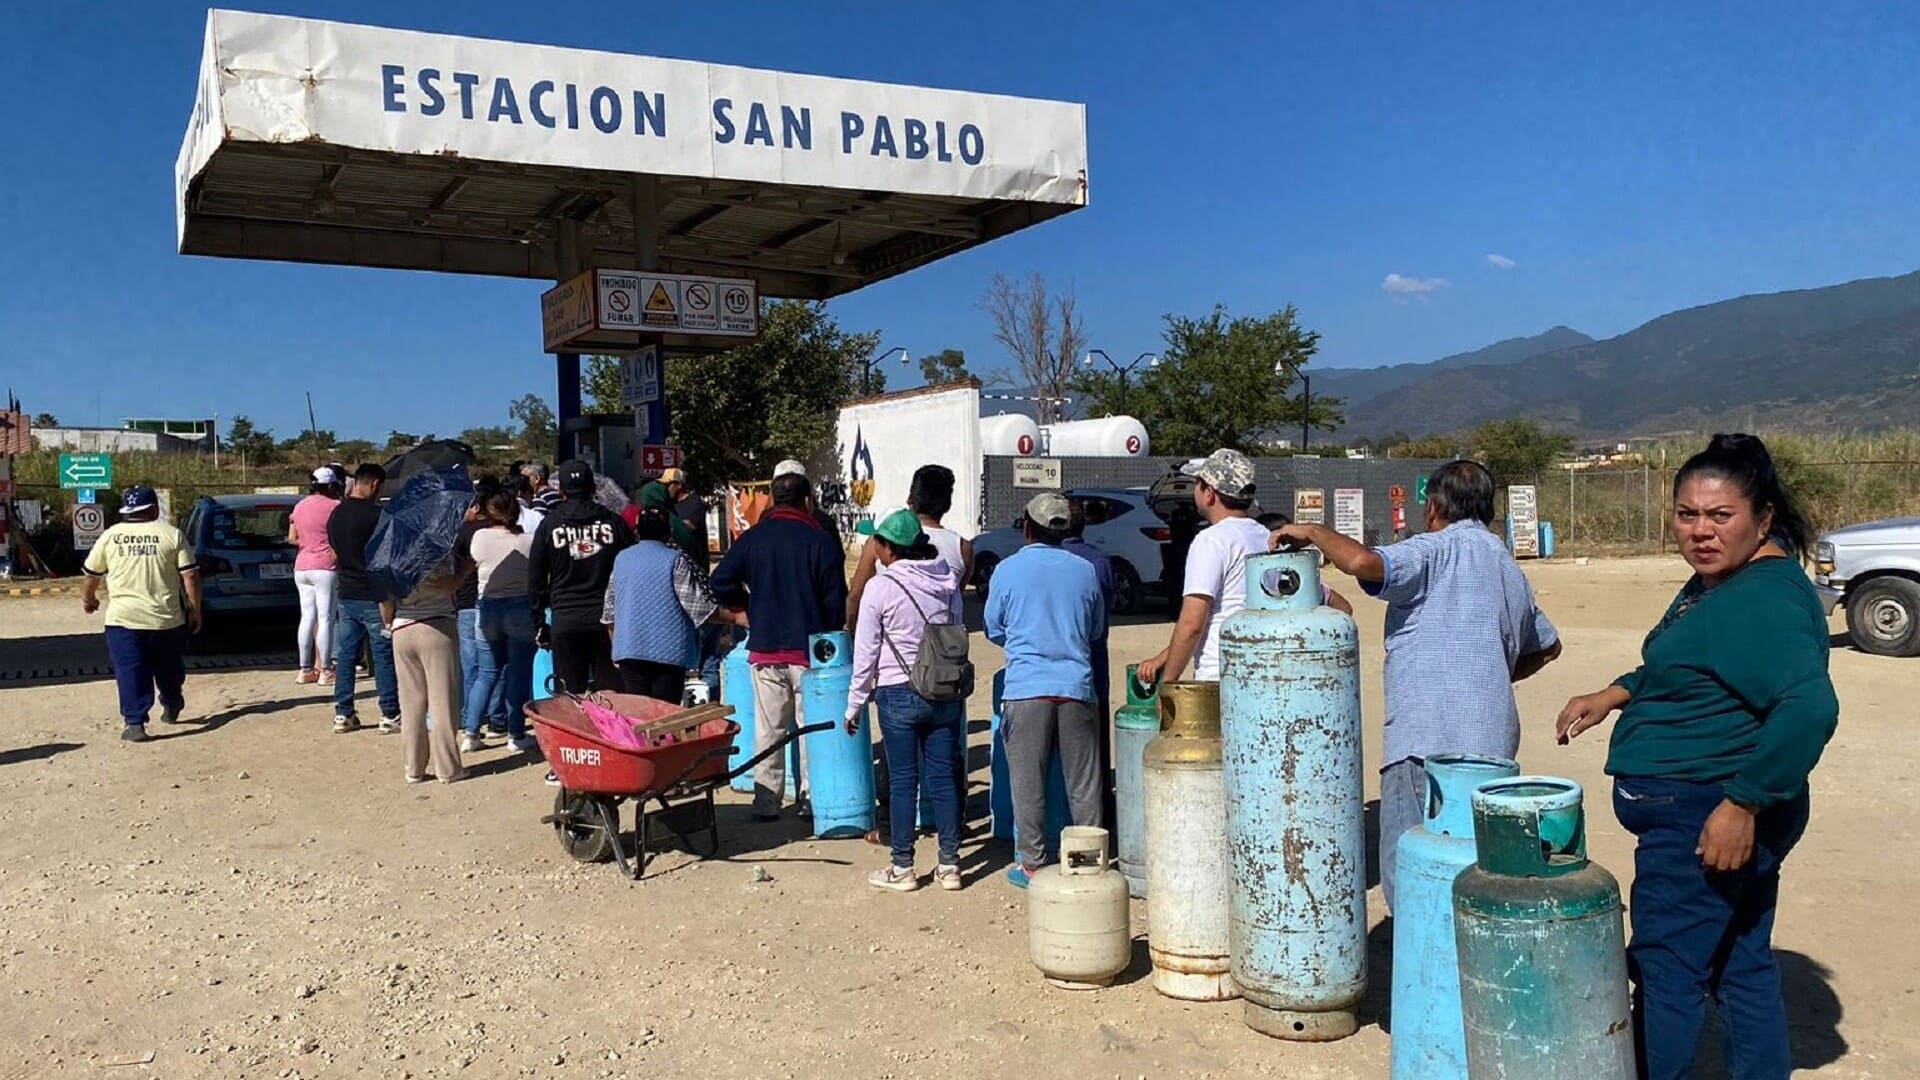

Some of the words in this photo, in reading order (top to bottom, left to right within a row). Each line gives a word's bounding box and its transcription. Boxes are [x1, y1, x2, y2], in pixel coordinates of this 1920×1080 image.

[383, 64, 666, 138] ESTACION
[713, 98, 812, 151] SAN
[842, 111, 985, 166] PABLO
[601, 277, 637, 289] PROHIBIDO
[729, 293, 746, 306] 10
[607, 312, 634, 323] FUMAR
[1023, 438, 1029, 451] 1
[1130, 438, 1138, 451] 2
[1045, 468, 1057, 477] 10
[79, 512, 97, 524] 10
[113, 532, 161, 545] Corona
[551, 521, 615, 549] CHIEFS
[559, 746, 601, 767] TRUPER
